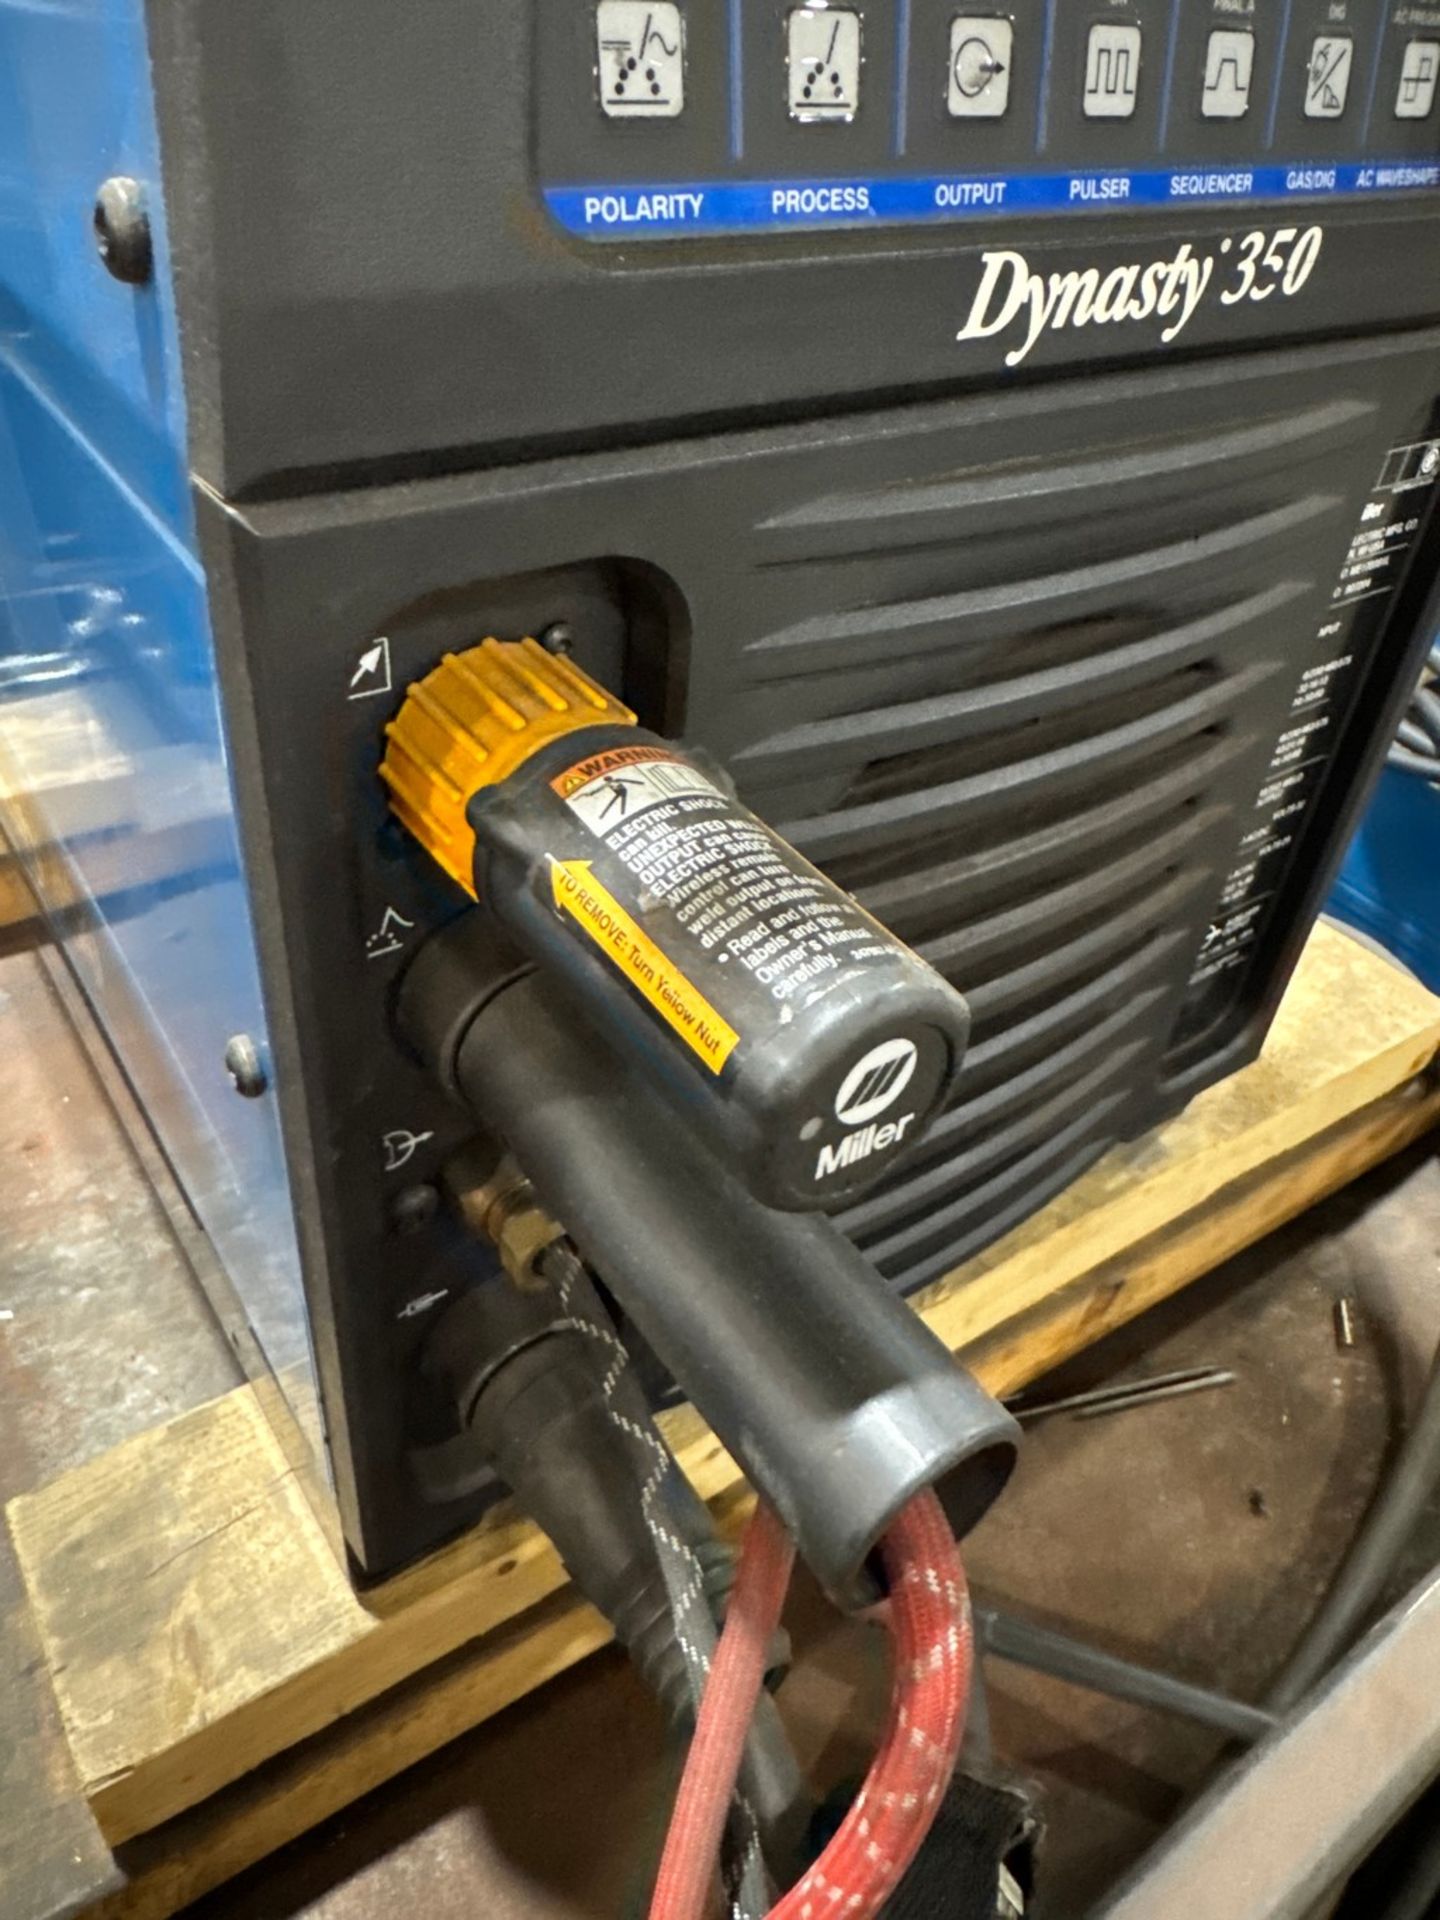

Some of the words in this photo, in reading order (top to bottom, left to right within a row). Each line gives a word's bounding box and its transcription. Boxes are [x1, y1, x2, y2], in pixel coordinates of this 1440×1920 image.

[772, 187, 869, 214] PROCESS
[935, 181, 1005, 206] OUTPUT
[1069, 178, 1131, 200] PULSER
[1169, 173, 1253, 196] SEQUENCER
[1286, 170, 1336, 190] GAS/DIG
[1356, 169, 1375, 187] AC
[585, 193, 704, 223] POLARITY
[956, 244, 1213, 366] Dynasty
[1221, 226, 1322, 304] 350
[605, 804, 680, 851] ELECTRIC
[618, 837, 648, 863] can
[627, 819, 728, 873] UNEXPECTED
[639, 839, 702, 885] OUTPUT
[703, 832, 733, 848] can
[649, 847, 726, 897] ELECTRIC
[666, 864, 731, 909] Wireless
[676, 880, 730, 922] control
[729, 869, 761, 886] can
[687, 900, 727, 935] weld
[725, 878, 777, 907] output
[774, 876, 797, 888] on
[700, 905, 755, 949] distant
[726, 921, 772, 956] Read
[770, 907, 801, 929] and
[740, 934, 790, 970] labels
[788, 919, 820, 940] and
[558, 873, 578, 892] TO
[575, 888, 630, 950] REMOVE:
[627, 944, 655, 983] Turn
[656, 974, 696, 1026] Yellow
[695, 1021, 721, 1056] Nut
[754, 940, 823, 984] Owner's
[771, 953, 842, 999] carefully.
[814, 1112, 916, 1181] Miller
